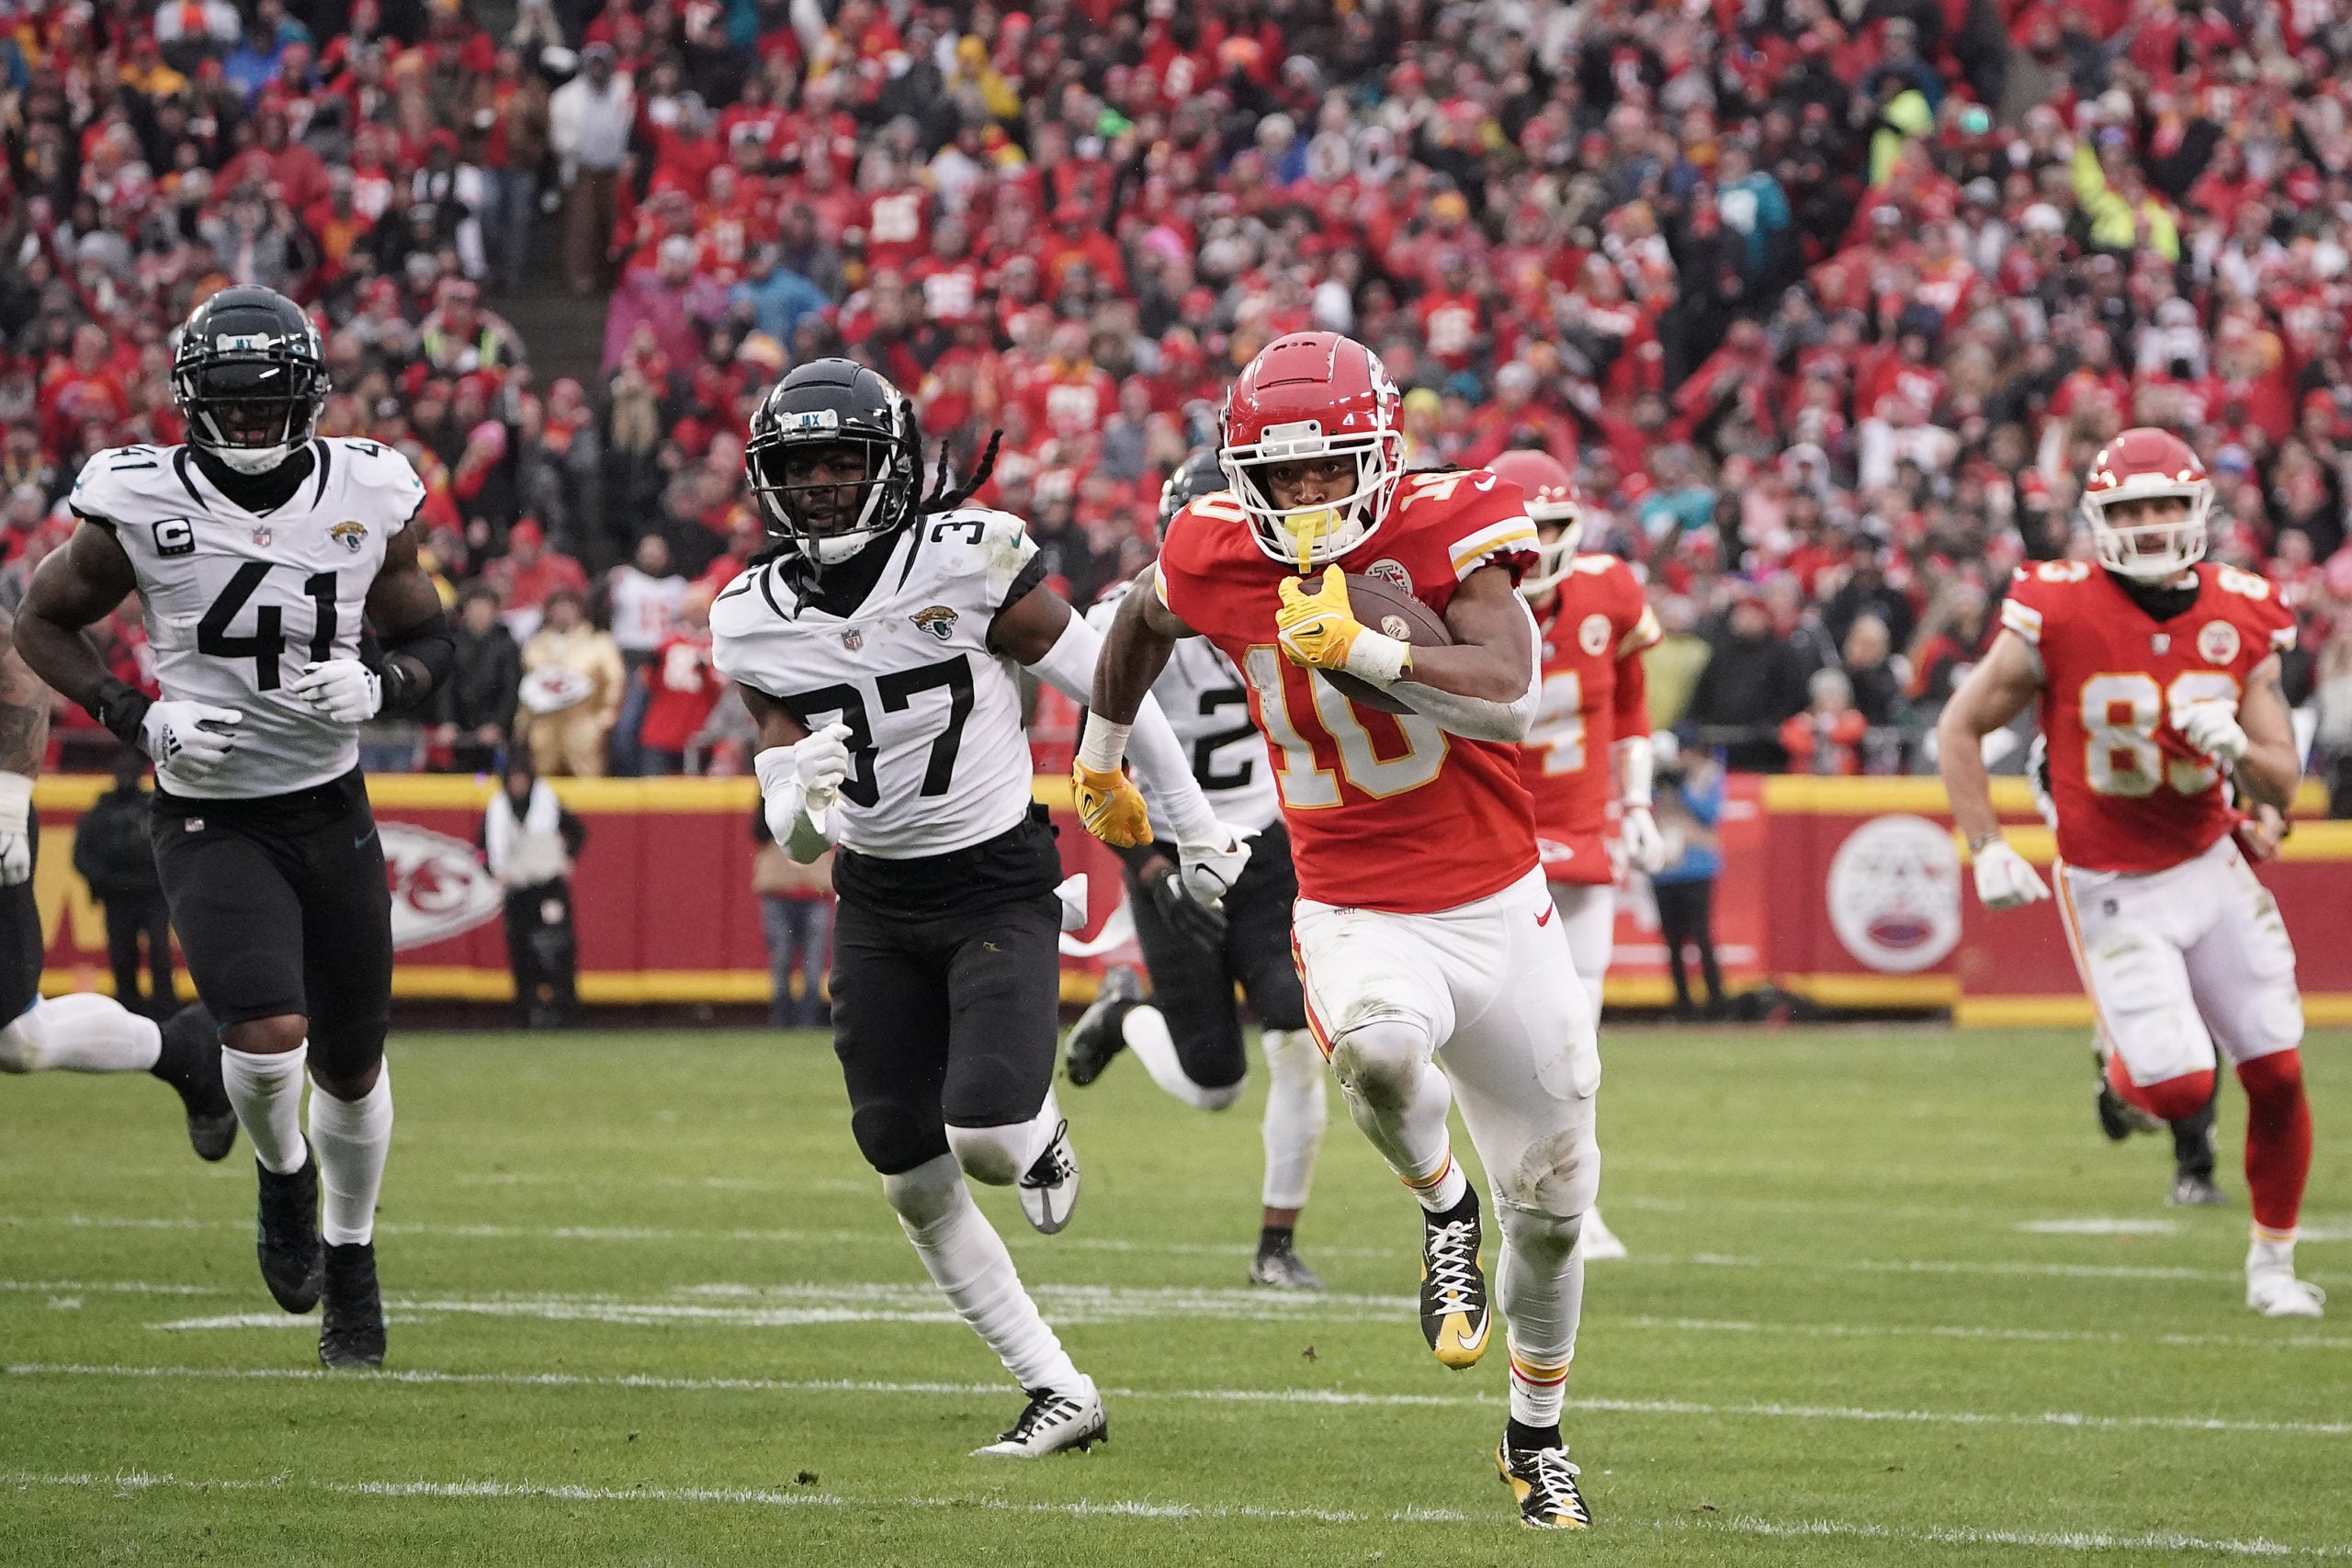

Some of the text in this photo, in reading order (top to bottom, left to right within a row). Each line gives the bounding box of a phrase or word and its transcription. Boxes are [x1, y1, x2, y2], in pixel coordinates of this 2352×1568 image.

[798, 413, 820, 427] JAX
[156, 519, 191, 548] C
[197, 561, 337, 692] 41
[779, 652, 975, 808] 37
[1242, 644, 1451, 809] 10
[1525, 670, 1587, 777] 4
